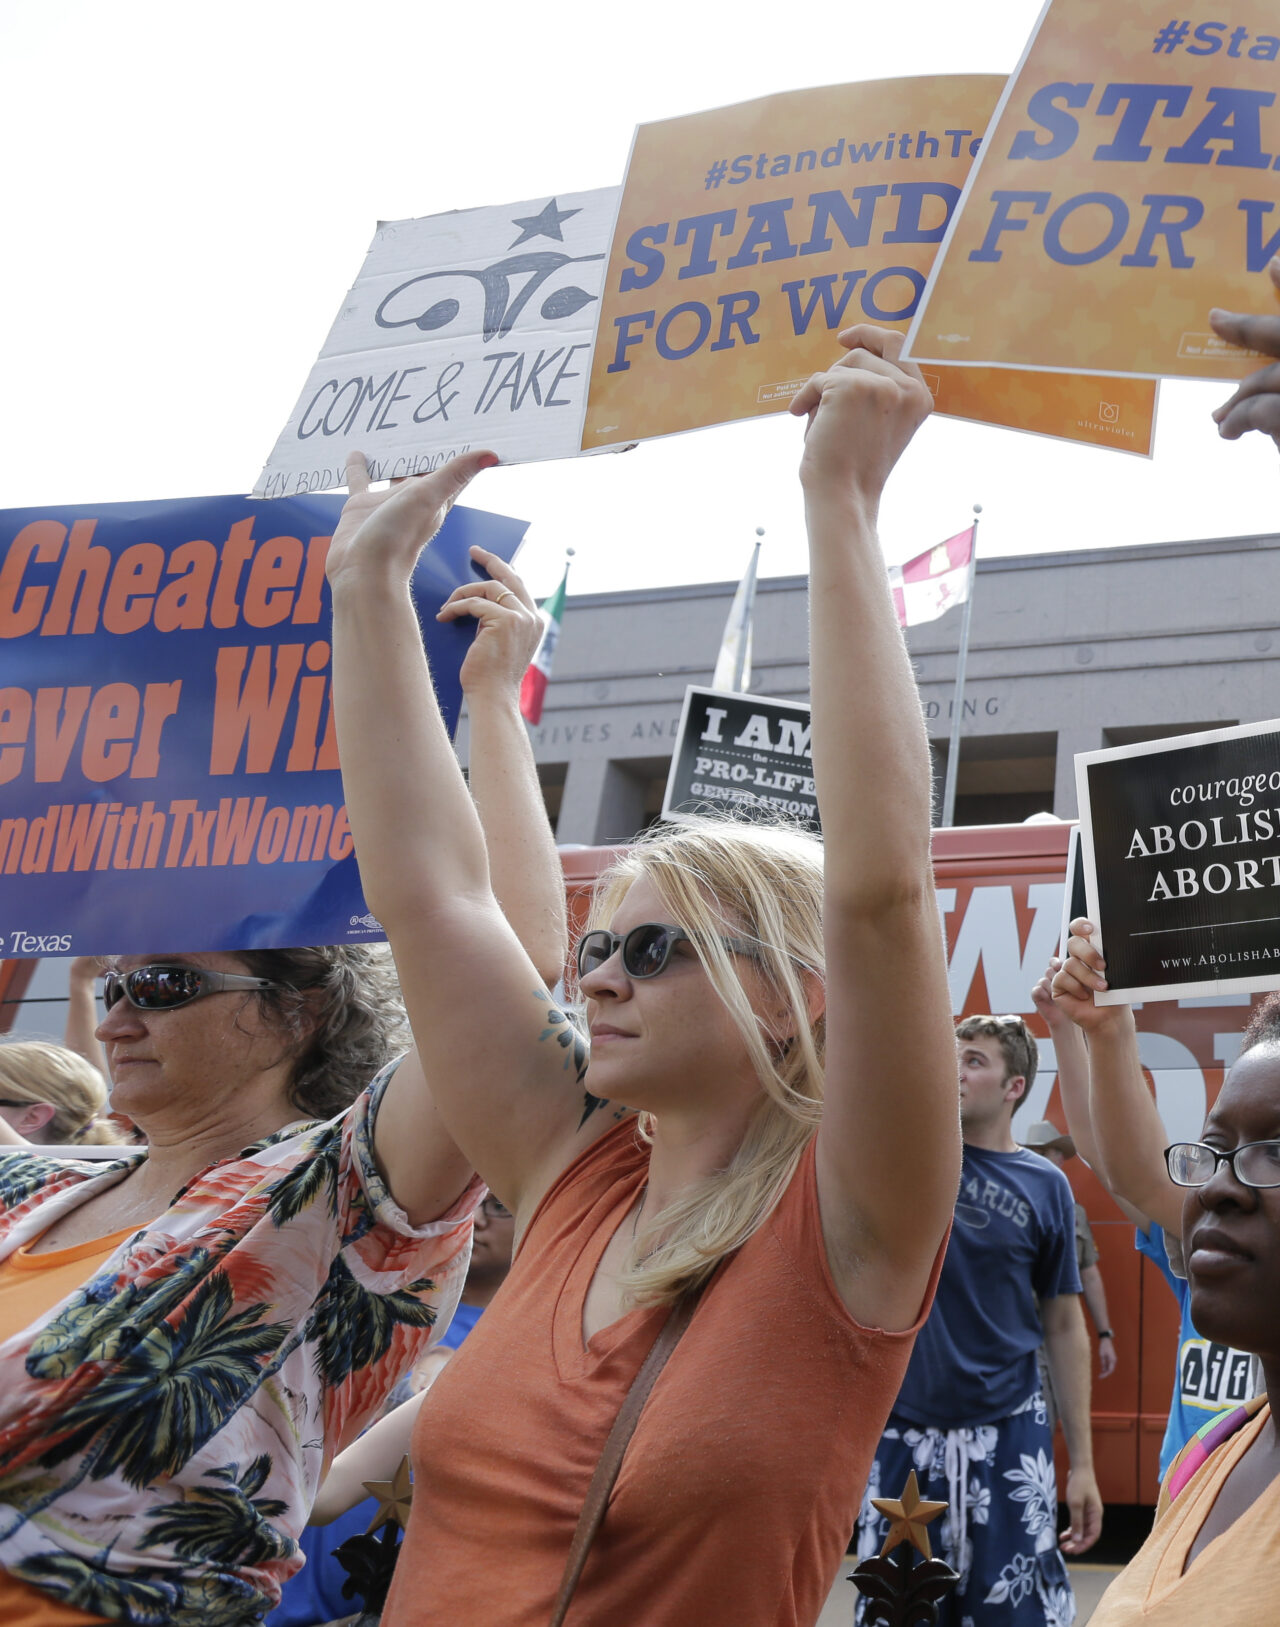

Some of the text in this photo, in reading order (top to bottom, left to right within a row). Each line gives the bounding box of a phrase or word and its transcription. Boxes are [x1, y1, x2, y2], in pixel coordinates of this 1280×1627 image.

[704, 129, 984, 190] #StandwithTe
[618, 182, 963, 293] STAND
[968, 189, 1205, 269] FOR
[607, 266, 928, 374] FOR WO
[297, 343, 591, 440] COME & TAKE
[1077, 420, 1135, 438] ultraviolet
[264, 472, 292, 498] MY
[0, 516, 333, 639] Cheater
[0, 680, 182, 786] ever
[700, 707, 812, 759] I AM
[927, 697, 999, 719] DING
[694, 757, 817, 797] PRO-LIFE
[752, 753, 768, 764] the
[0, 796, 357, 875] ndWithTxWome
[10, 931, 72, 953] Texas
[1184, 1350, 1249, 1397] Lif
